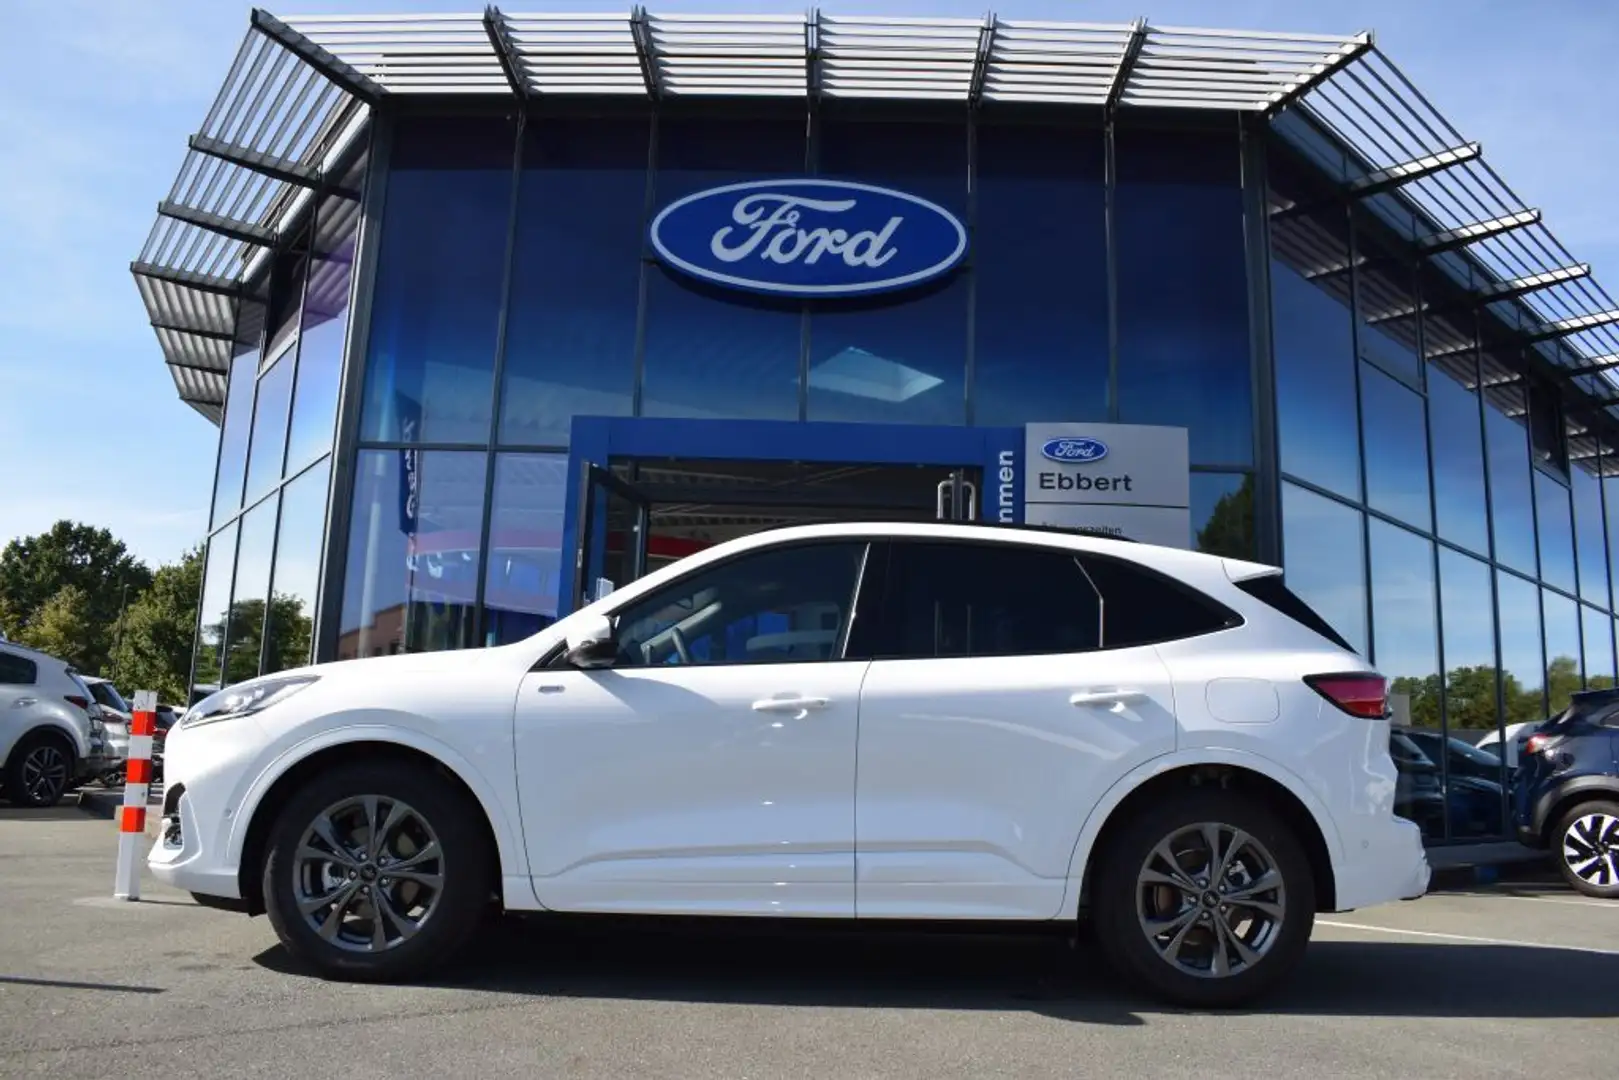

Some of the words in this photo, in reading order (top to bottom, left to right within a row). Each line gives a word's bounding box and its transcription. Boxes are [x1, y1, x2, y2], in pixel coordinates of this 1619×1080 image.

[711, 194, 904, 268] Ford
[1055, 441, 1095, 458] Ford
[1039, 472, 1133, 492] Ebbert
